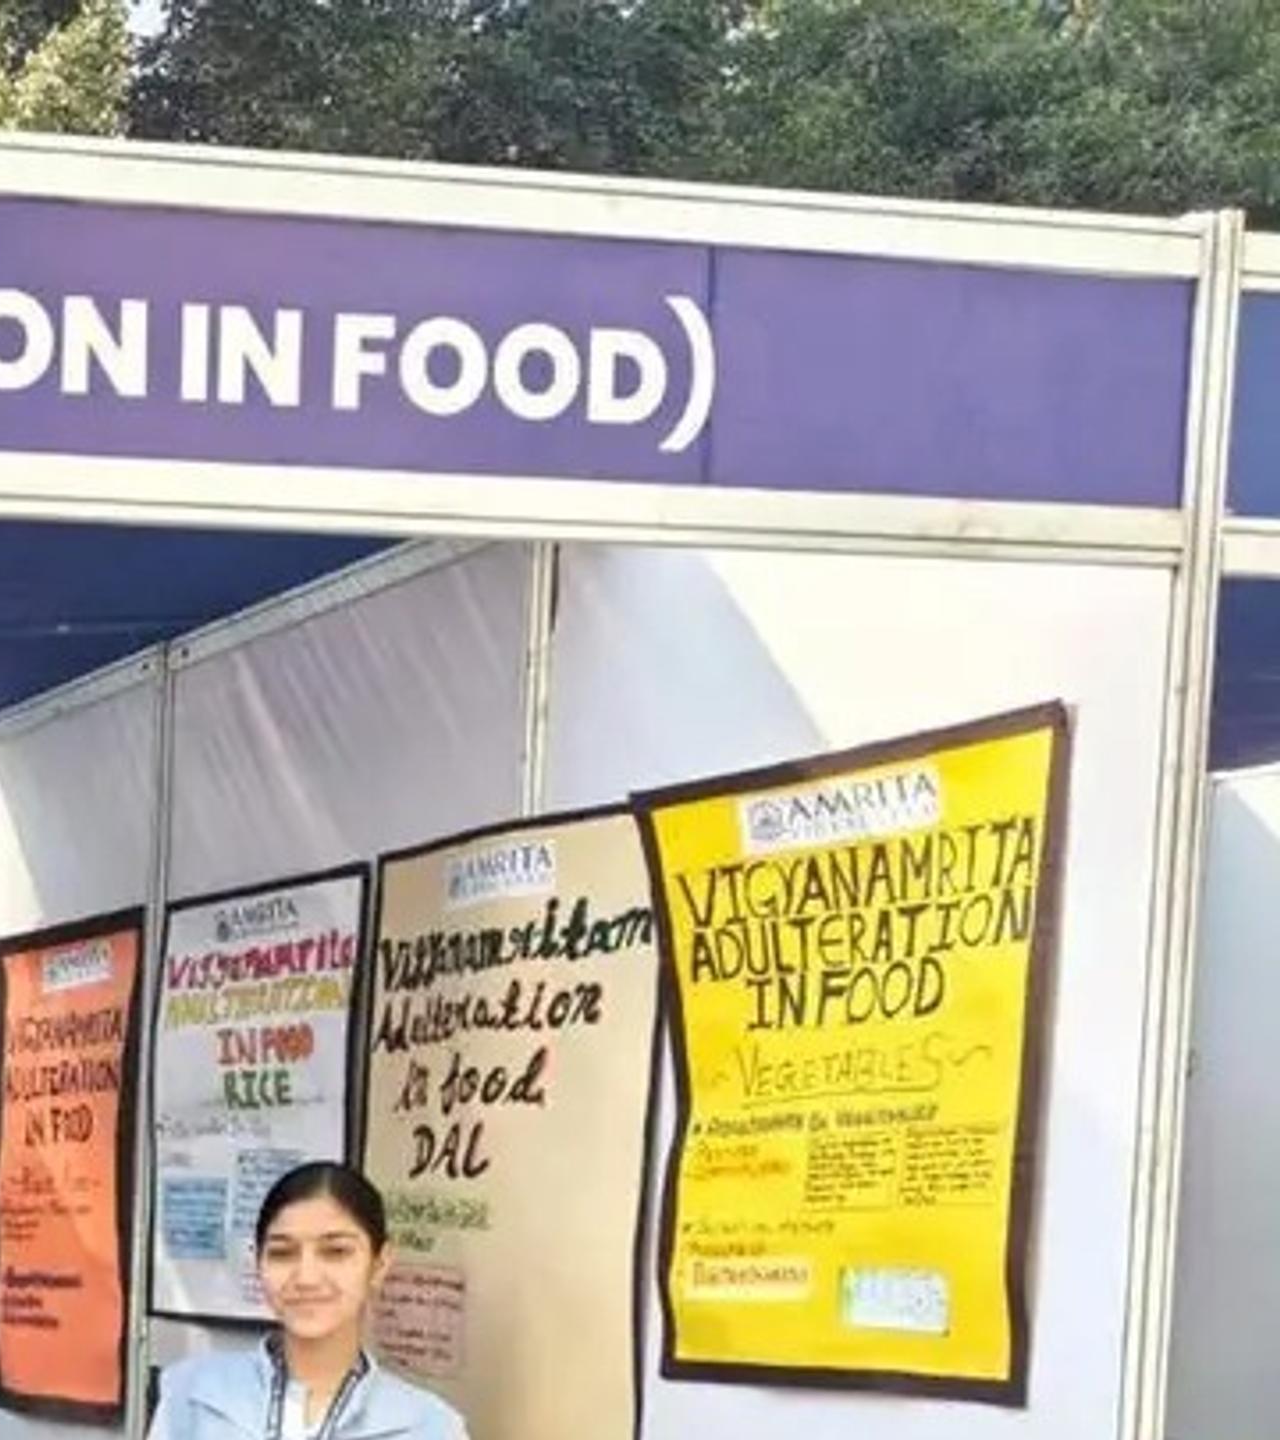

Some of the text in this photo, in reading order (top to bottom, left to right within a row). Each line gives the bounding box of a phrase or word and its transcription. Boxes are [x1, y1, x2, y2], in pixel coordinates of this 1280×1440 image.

[181, 303, 302, 407] IN
[332, 296, 715, 452] FOOD)
[790, 773, 937, 822] AMRITA
[677, 818, 1036, 929] VIGYANAMRITA
[691, 886, 1032, 982] ADULTERATION
[746, 956, 945, 1031] IN FOOD
[223, 1068, 293, 1108] RICE
[409, 1123, 489, 1179] DAL
